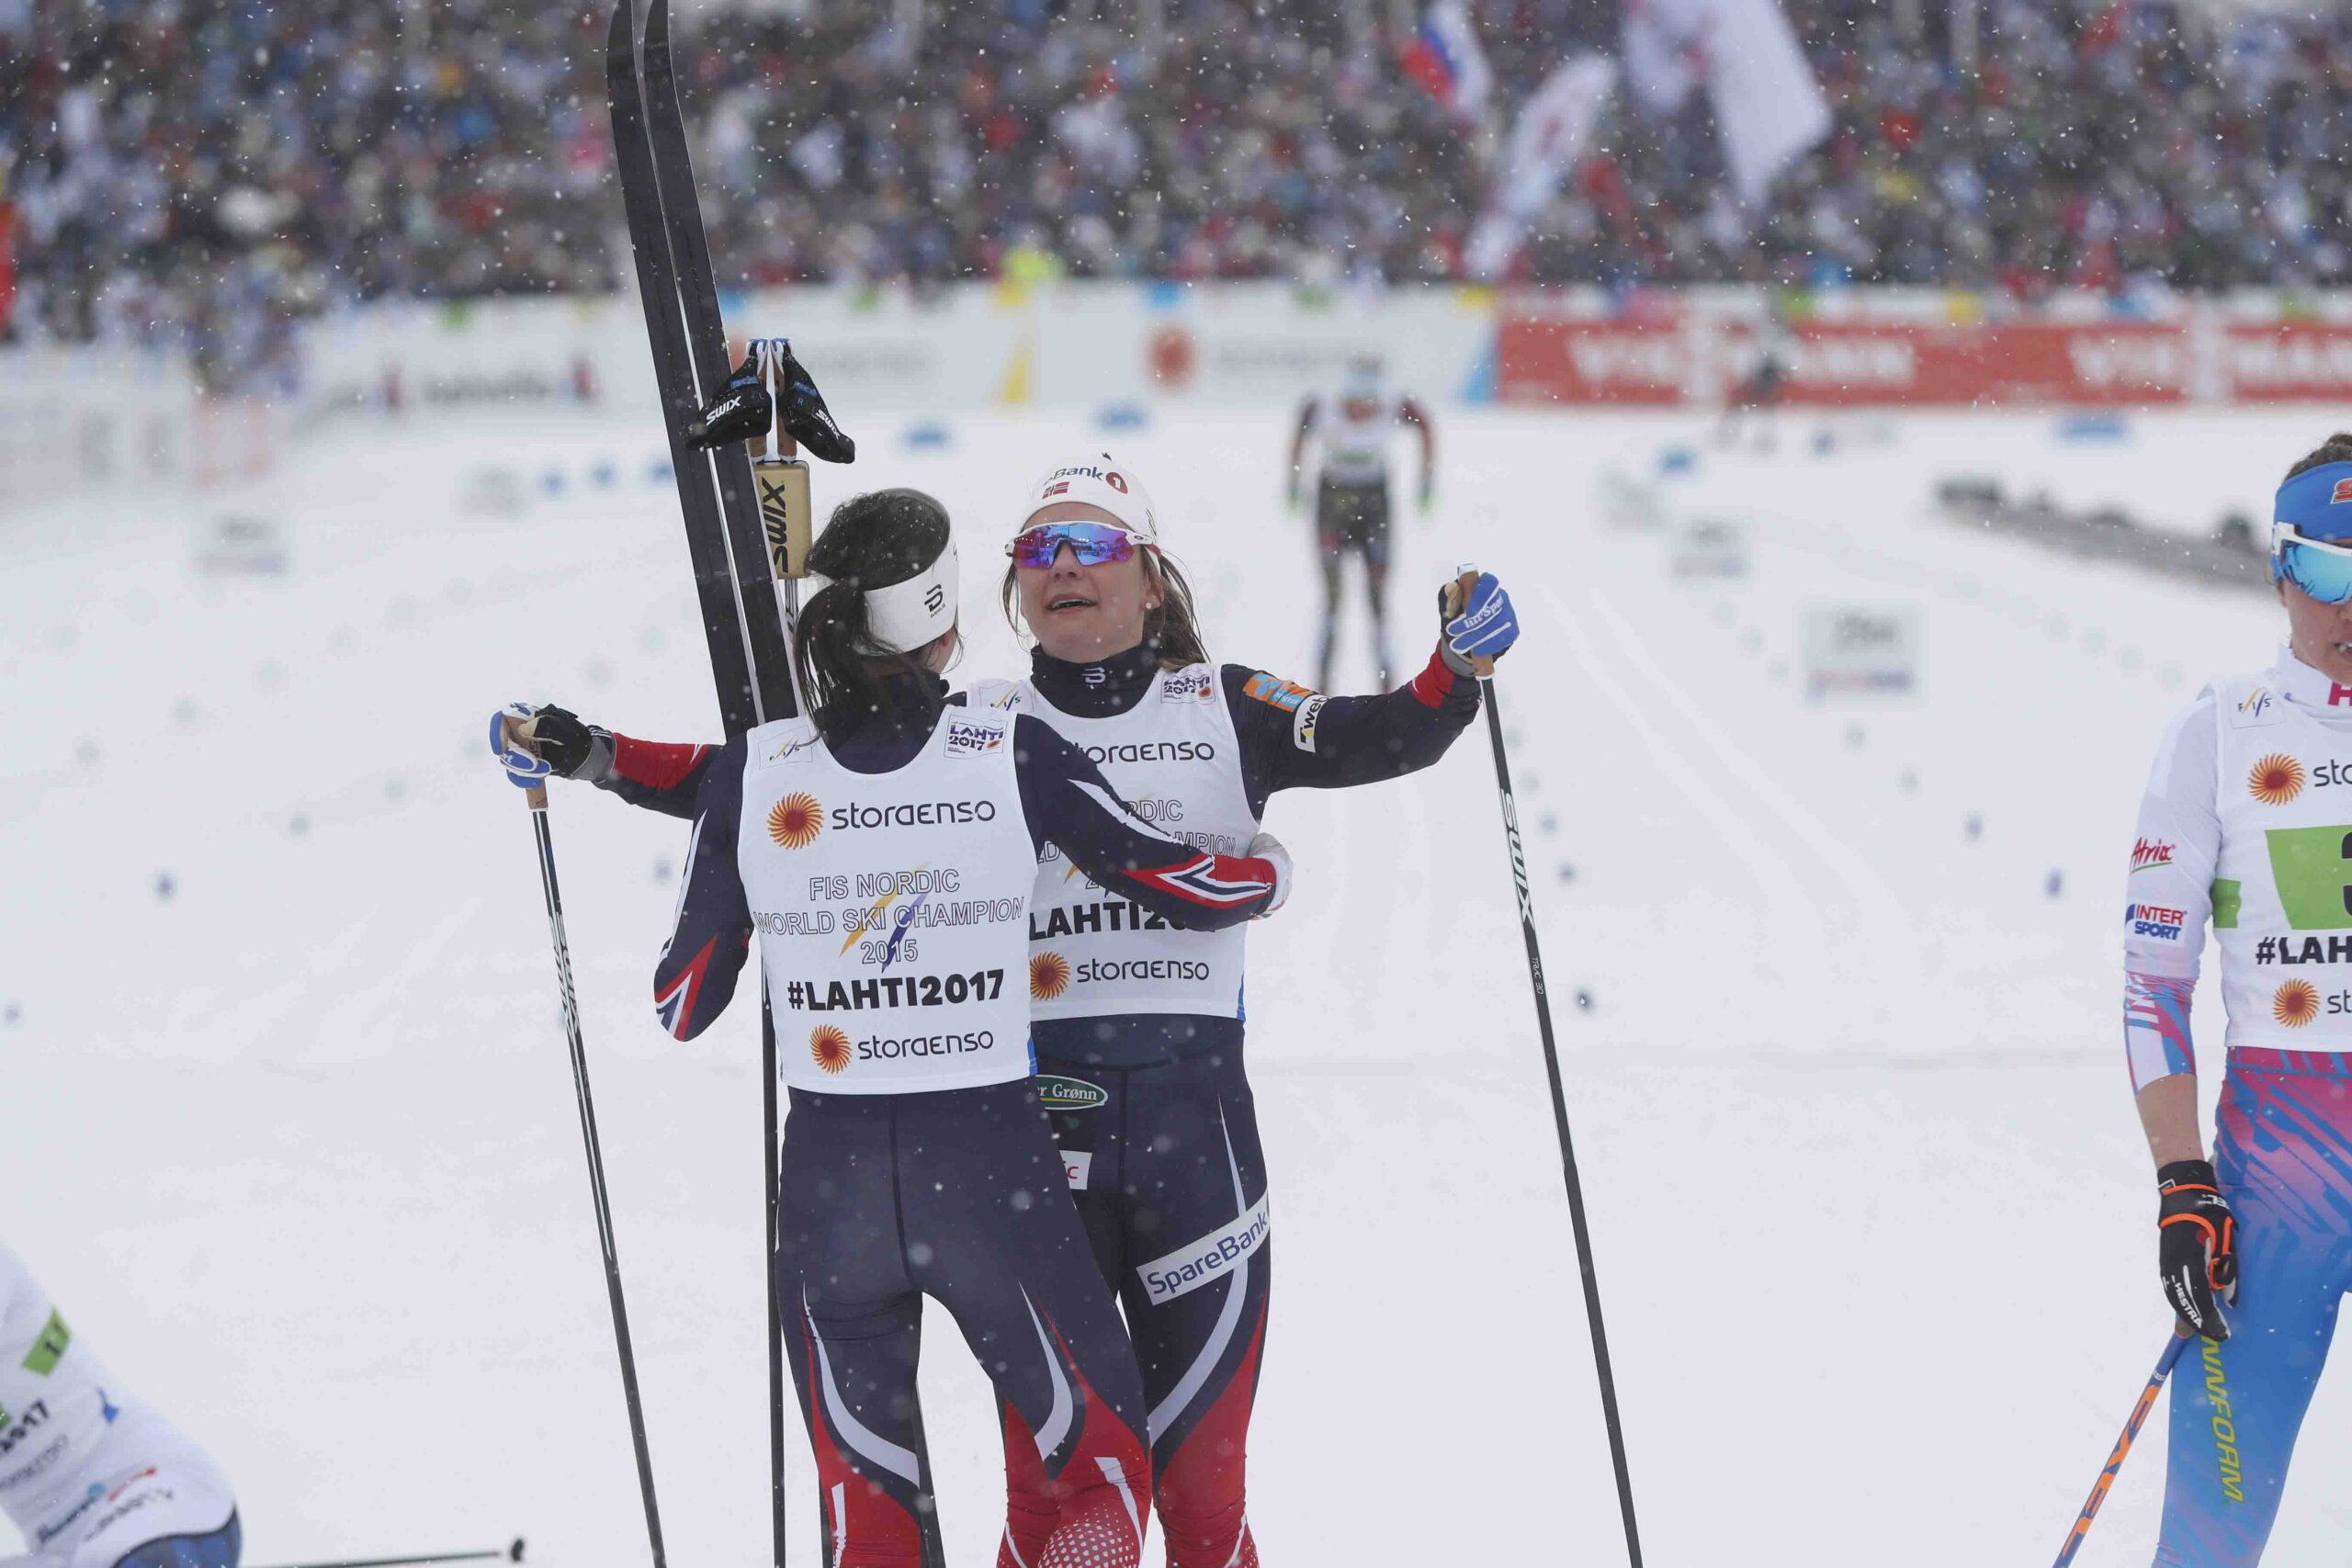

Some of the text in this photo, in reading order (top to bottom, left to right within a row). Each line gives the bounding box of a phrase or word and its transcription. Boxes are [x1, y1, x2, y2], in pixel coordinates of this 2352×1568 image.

[706, 395, 741, 426] SWIX
[815, 409, 841, 440] SWIX
[761, 476, 788, 574] SWIX
[948, 735, 986, 751] 2017
[949, 724, 1004, 740] LAHTI
[831, 800, 996, 830] storaenso
[1499, 788, 1535, 931] SWIX
[809, 868, 961, 901] FIS NORDIC
[752, 896, 1025, 936] WORLD SKI CHAMPION
[2135, 904, 2184, 926] INTER
[2134, 920, 2181, 941] SPORT
[860, 939, 919, 964] 2015
[1077, 958, 1210, 984] storaenso
[787, 968, 1004, 1011] #LAHTI2017
[857, 1031, 994, 1060] storaenso
[1052, 1083, 1098, 1101] Grønn
[1147, 1211, 1267, 1295] SpareBank
[2174, 1282, 2205, 1330] HESTRA
